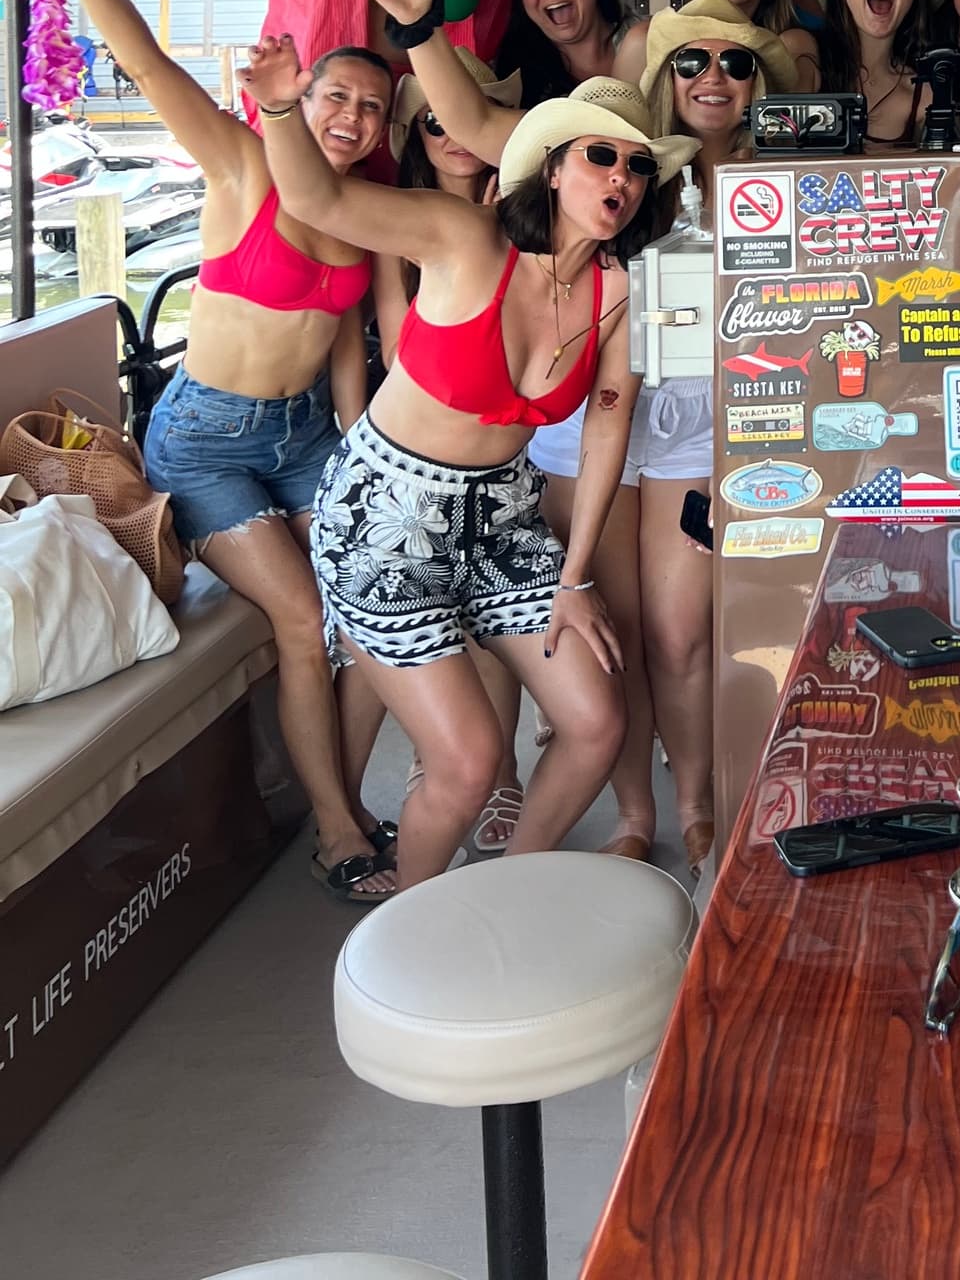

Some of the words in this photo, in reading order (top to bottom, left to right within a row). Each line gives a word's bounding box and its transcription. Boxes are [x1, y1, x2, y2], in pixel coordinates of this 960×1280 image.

[798, 167, 947, 216] SALTY
[799, 208, 949, 257] CREW
[726, 243, 742, 251] NO
[743, 241, 788, 251] SMOKING
[807, 258, 832, 267] FIND
[837, 254, 879, 265] REFUGE
[883, 254, 895, 263] IN
[900, 252, 920, 262] THE
[924, 252, 945, 261] SEA
[742, 285, 755, 297] the
[762, 280, 861, 304] FLORIDA
[903, 276, 954, 293] Marsh
[728, 302, 802, 334] flavor
[901, 308, 950, 324] Captain
[901, 326, 920, 343] To
[924, 348, 947, 357] Please
[733, 381, 774, 398] SIESTA
[780, 379, 801, 395] KEY
[738, 407, 769, 418] BEACH
[771, 407, 792, 417] MIX
[754, 486, 789, 501] CBs
[32, 961, 73, 1036] LIFE
[84, 842, 192, 982] PRESERVERS
